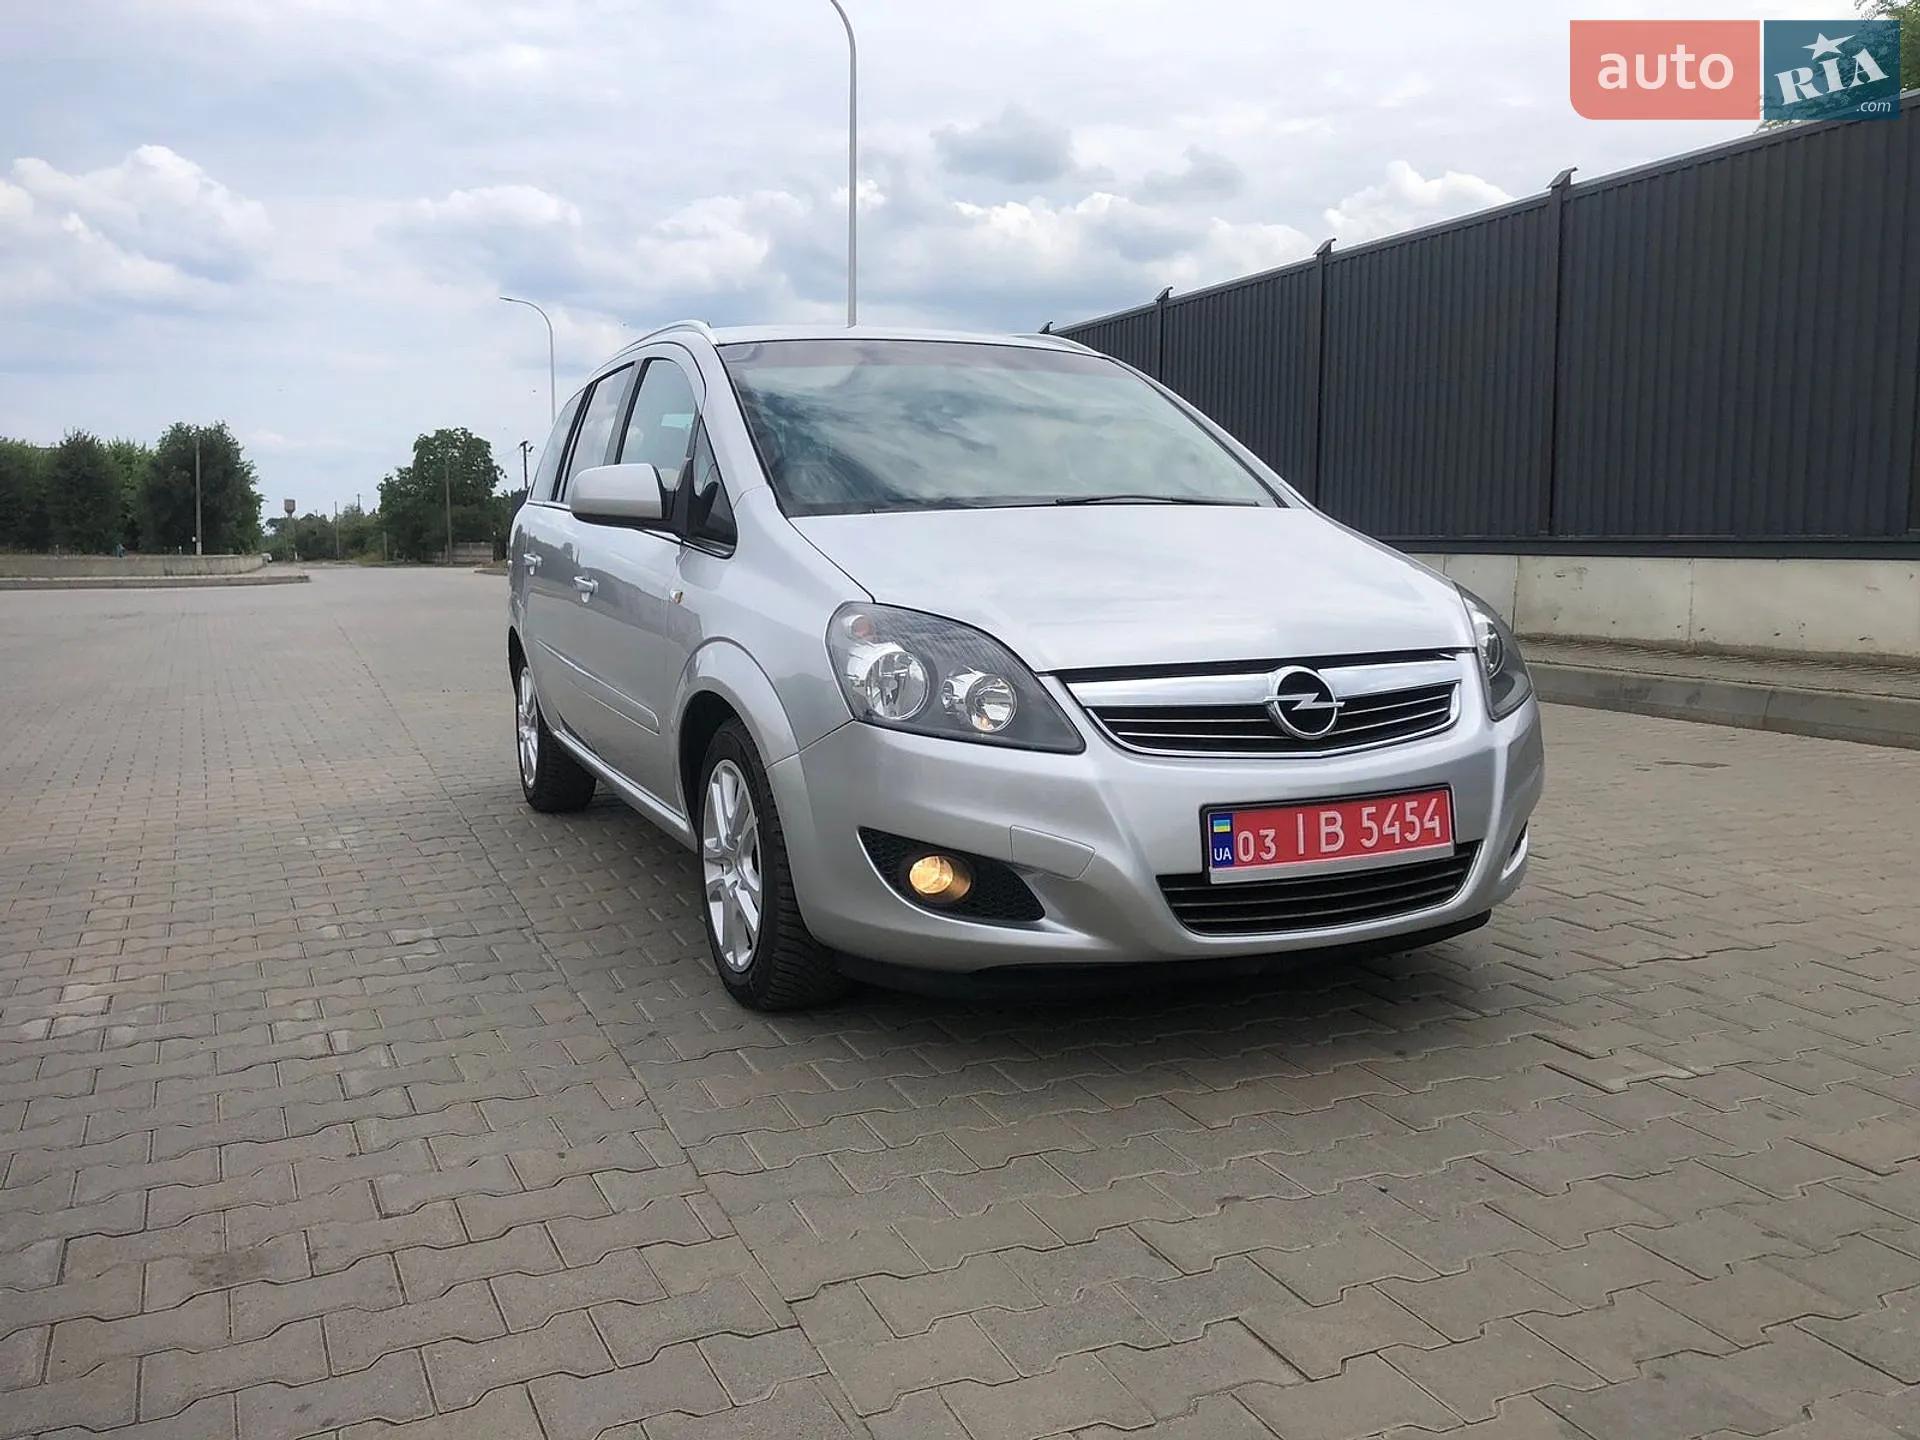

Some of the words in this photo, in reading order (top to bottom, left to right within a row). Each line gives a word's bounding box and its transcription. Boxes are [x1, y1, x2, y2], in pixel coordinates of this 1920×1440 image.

[1237, 829, 1277, 862] 03
[1360, 798, 1441, 849] 5454
[1213, 847, 1232, 862] UA
